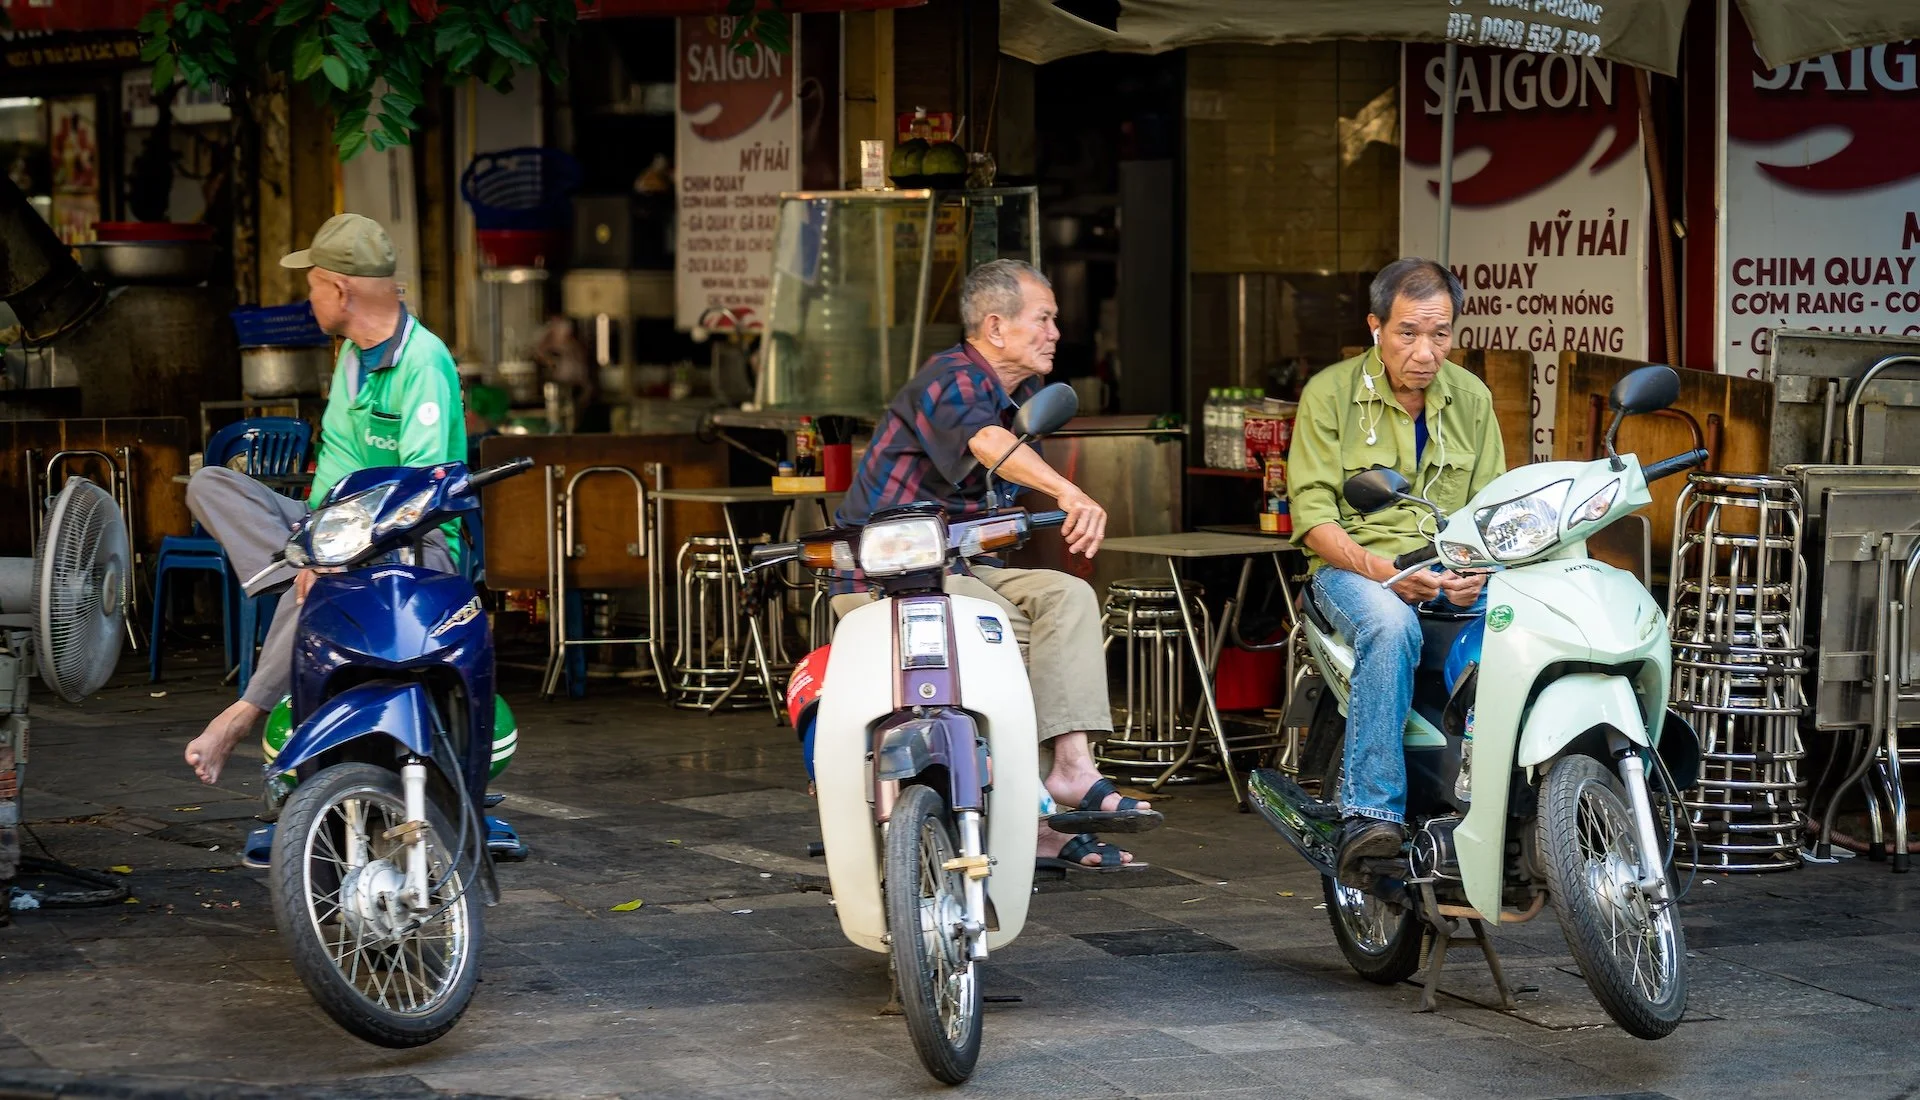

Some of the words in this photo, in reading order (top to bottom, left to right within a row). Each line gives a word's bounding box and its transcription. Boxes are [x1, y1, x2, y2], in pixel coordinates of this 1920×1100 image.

[1479, 16, 1525, 49] 0968
[1525, 23, 1562, 53] 552
[688, 43, 781, 83] SAIGON
[1424, 53, 1613, 115] SAIGON
[1528, 209, 1573, 256] MỸ
[1577, 208, 1629, 256] HẢI
[1474, 263, 1538, 290] QUAY
[1732, 257, 1815, 286] CHIM
[1824, 256, 1916, 286] QUAY
[1517, 294, 1557, 315] CƠM
[1562, 289, 1614, 315] NÓNG
[1731, 291, 1789, 315] CƠM
[1796, 292, 1864, 314] RANG
[1528, 319, 1557, 352] GÀ
[1563, 326, 1625, 353] RANG
